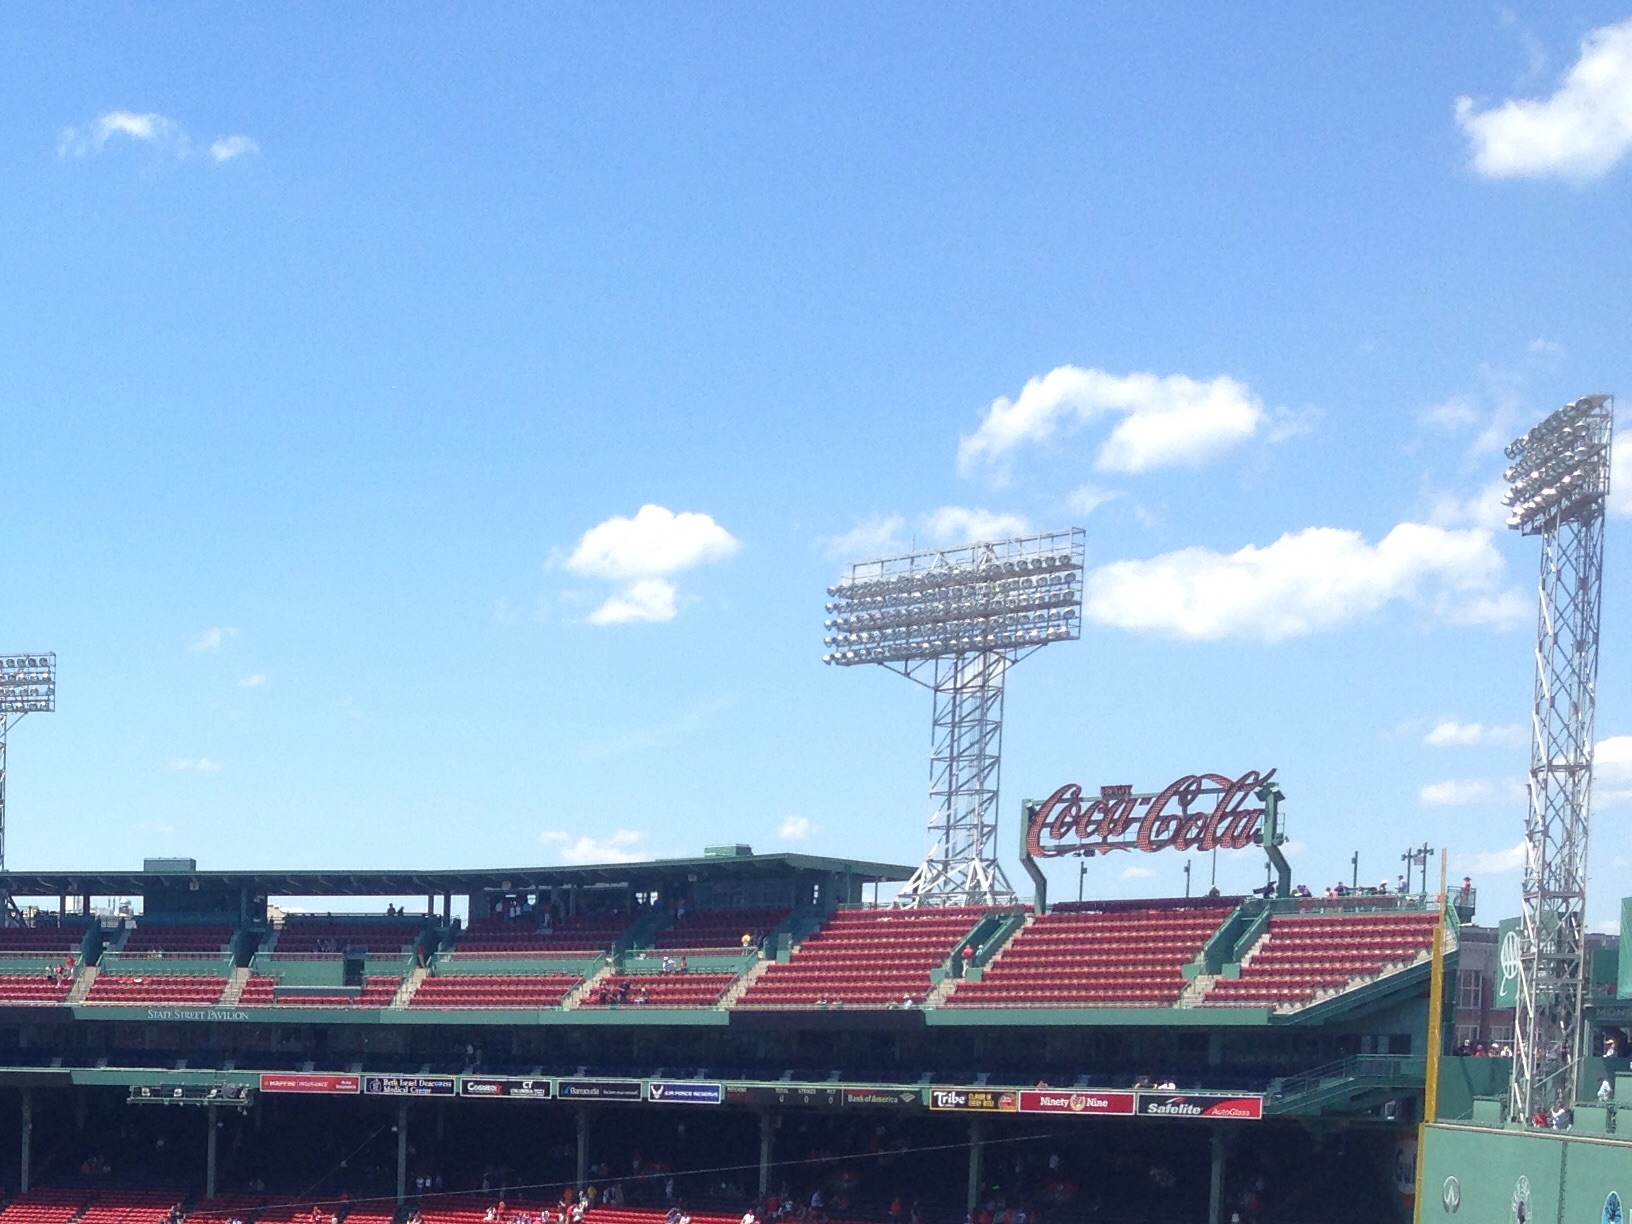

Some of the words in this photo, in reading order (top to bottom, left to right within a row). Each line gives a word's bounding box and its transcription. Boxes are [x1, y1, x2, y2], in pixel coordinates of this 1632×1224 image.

[1026, 767, 1278, 858] Coca-Cola
[147, 1009, 172, 1019] STATE
[174, 1010, 204, 1020] STREET
[206, 1010, 249, 1020] PAVILION
[383, 1079, 397, 1087] Beth
[399, 1079, 417, 1087] Israel
[383, 1086, 408, 1094] Medical
[847, 1094, 863, 1103] Bank
[871, 1095, 898, 1104] America
[933, 1091, 966, 1107] Tribe
[1039, 1096, 1069, 1108] Ninety
[1086, 1098, 1108, 1107] Nine
[1147, 1103, 1201, 1115] Safelite
[1211, 1107, 1250, 1116] AutoGlass
